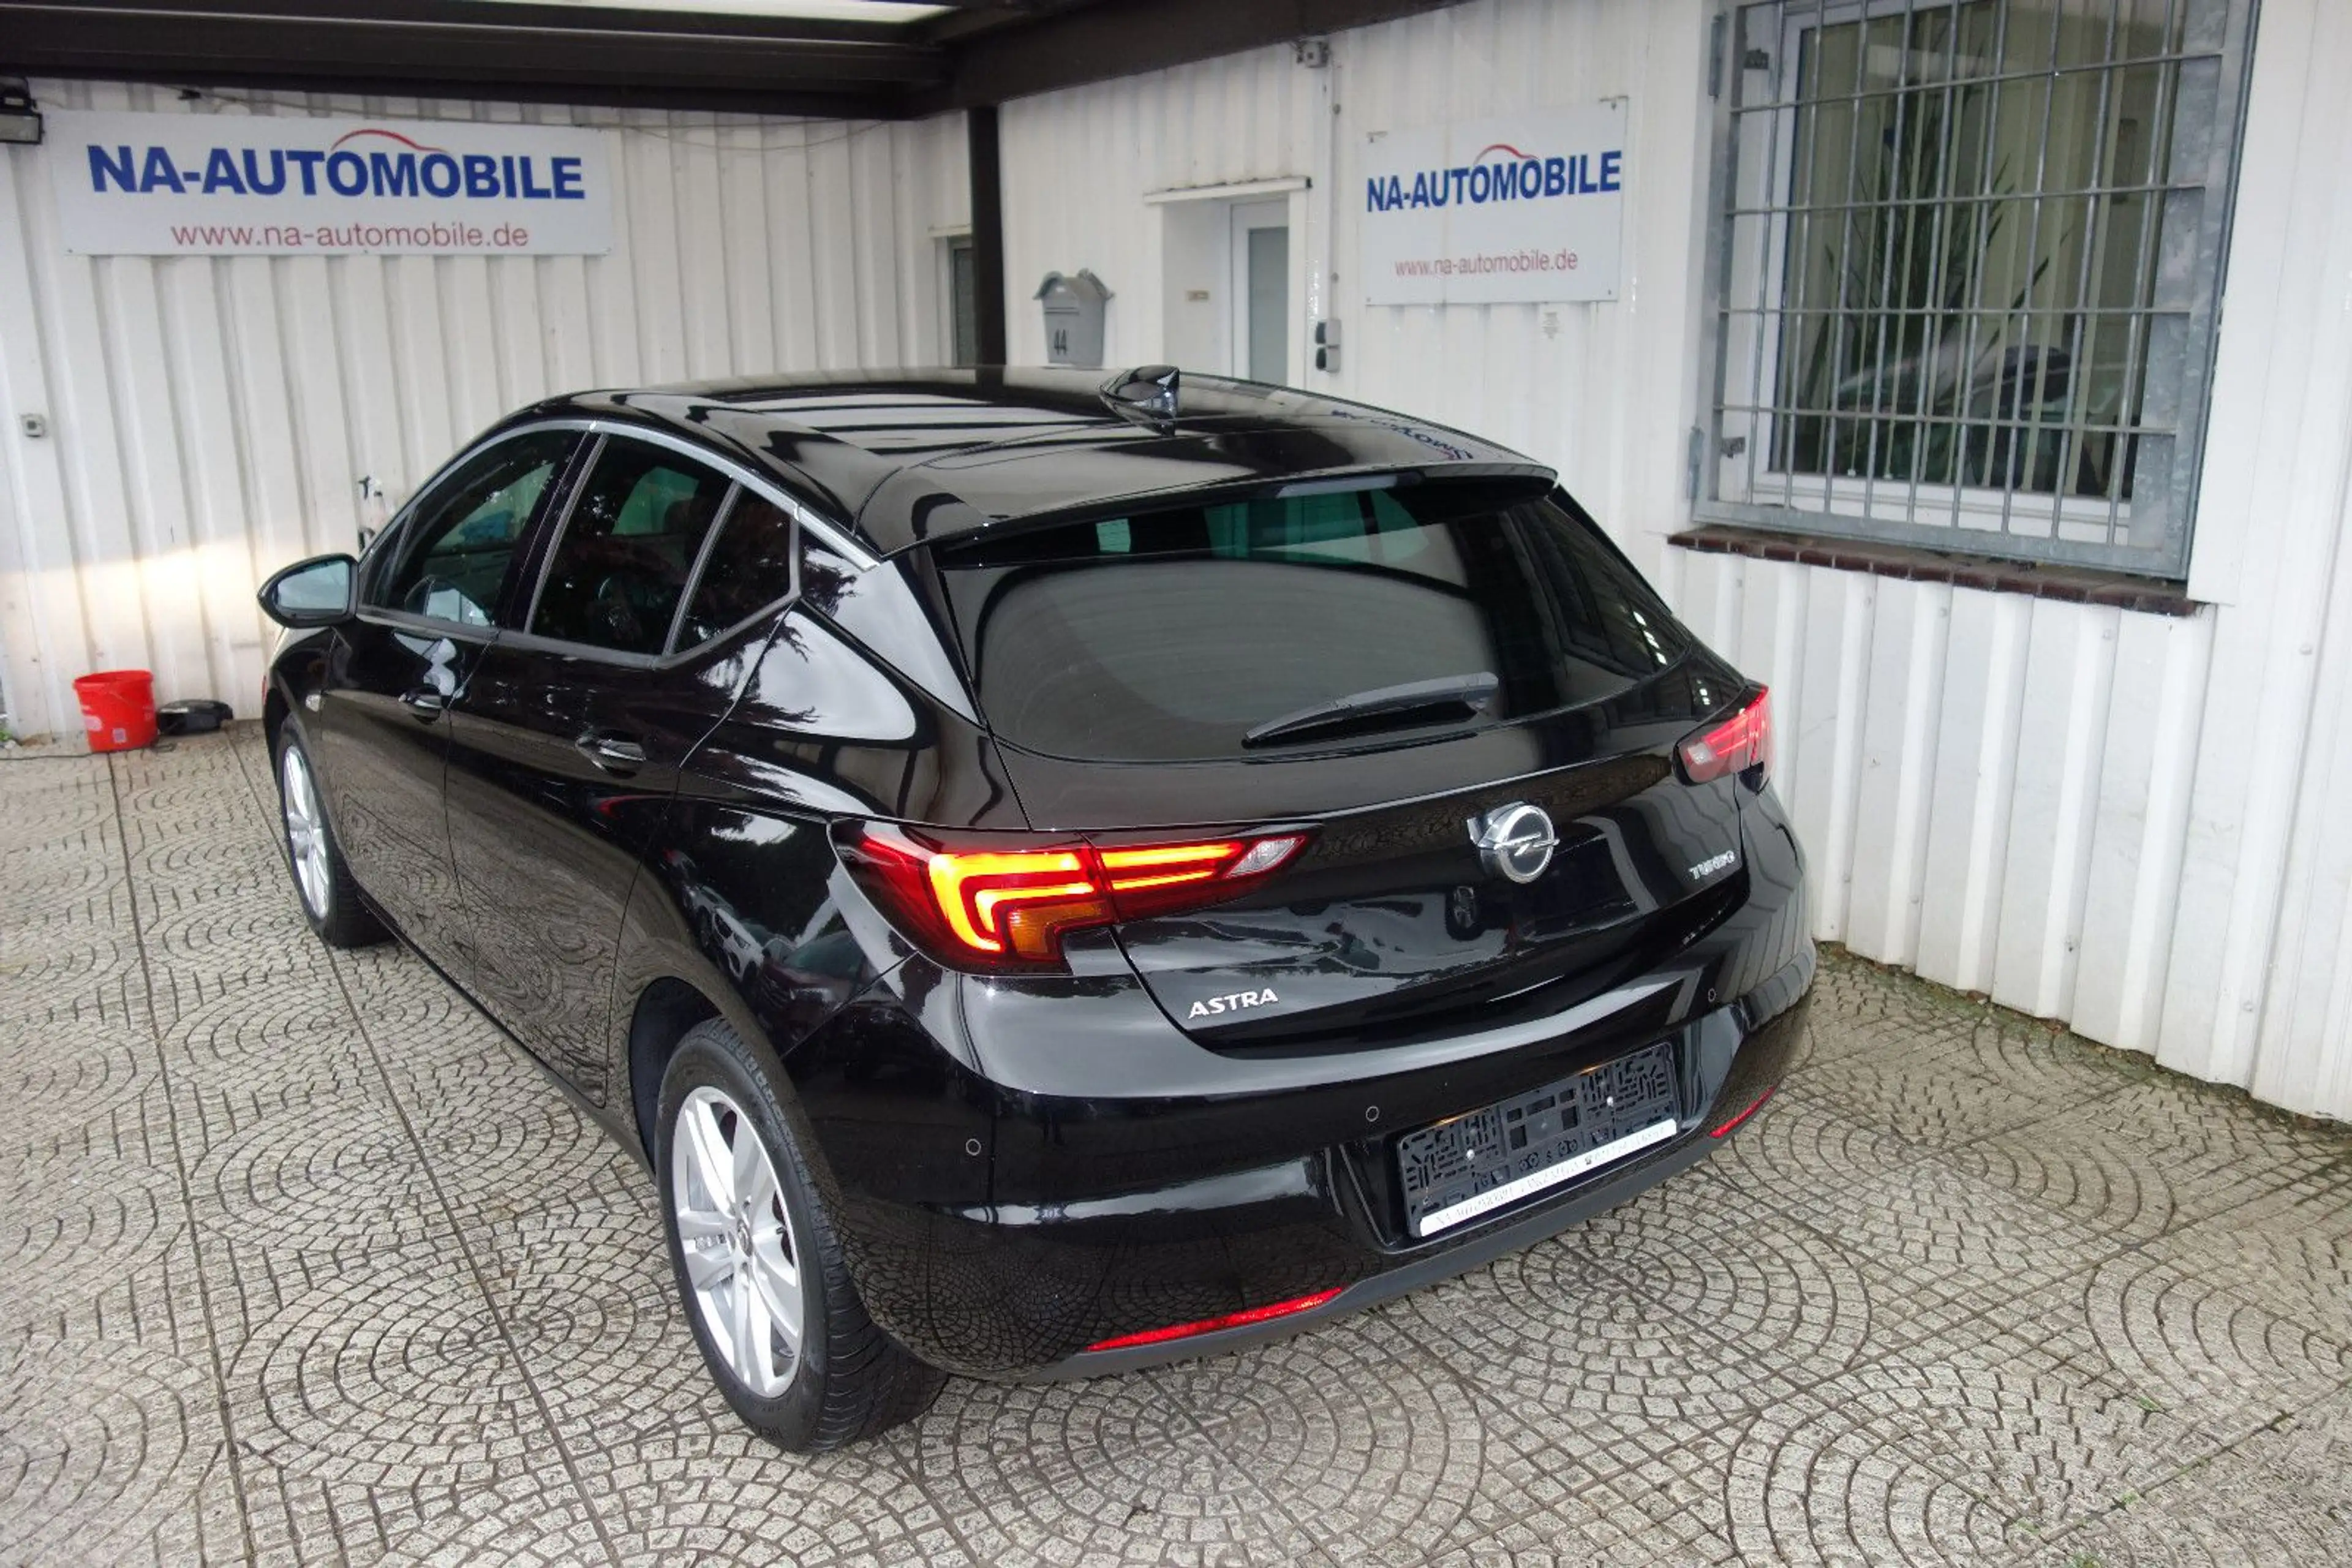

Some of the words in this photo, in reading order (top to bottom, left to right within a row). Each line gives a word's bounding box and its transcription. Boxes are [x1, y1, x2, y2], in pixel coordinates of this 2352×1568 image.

[87, 144, 585, 200] NA-AUTOMOBILE
[1366, 151, 1621, 212] NA-AUTOMOBILE
[172, 222, 528, 247] www.na-automobile.de
[1395, 249, 1578, 276] www.na-automobile.de
[1054, 328, 1067, 355] 44
[1188, 988, 1278, 1019] ASTRA
